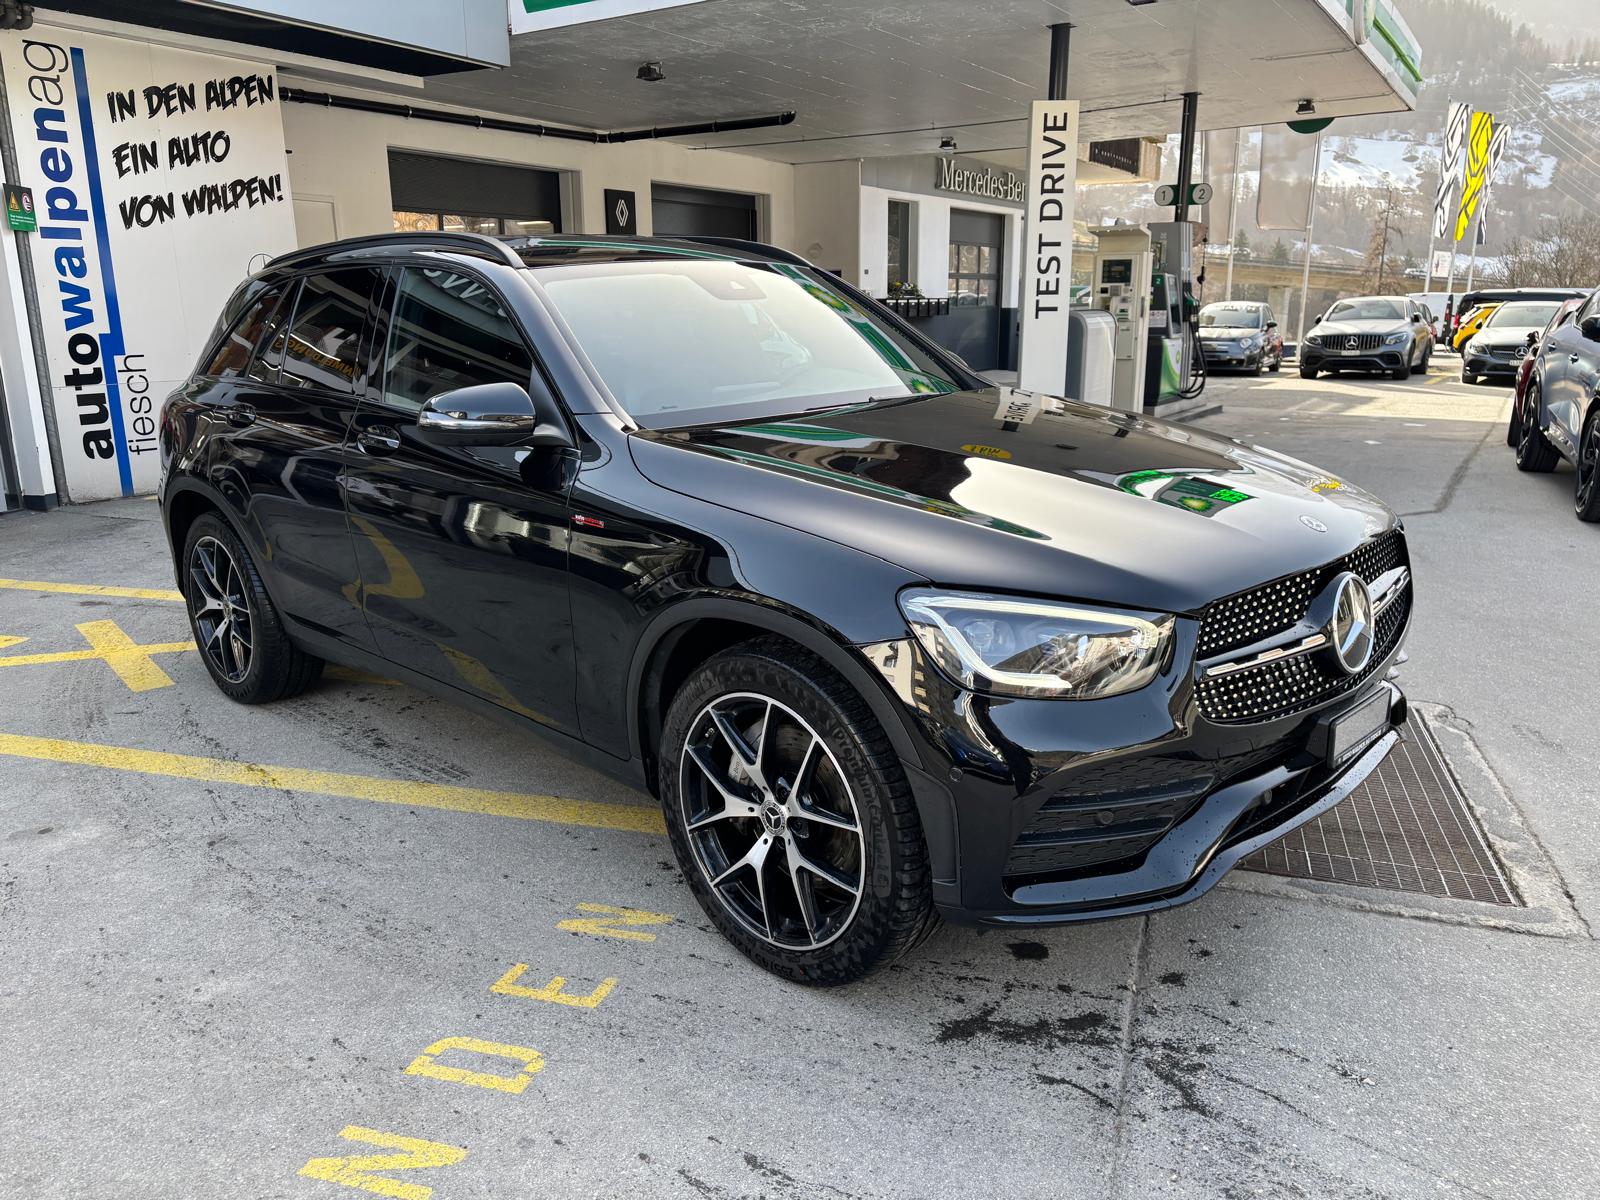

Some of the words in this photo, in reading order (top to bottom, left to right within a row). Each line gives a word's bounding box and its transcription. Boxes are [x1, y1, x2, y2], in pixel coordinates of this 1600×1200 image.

[106, 90, 137, 123] IN
[143, 83, 196, 119] DEN
[205, 73, 274, 112] ALPEN
[112, 141, 159, 179] EIN
[169, 130, 231, 170] AUTO
[1039, 111, 1068, 222] DRIVE
[119, 192, 175, 230] VON
[182, 173, 284, 218] WALPEN!
[1198, 188, 1206, 200] 2
[1034, 233, 1062, 320] TEST
[117, 353, 158, 455] fiesch
